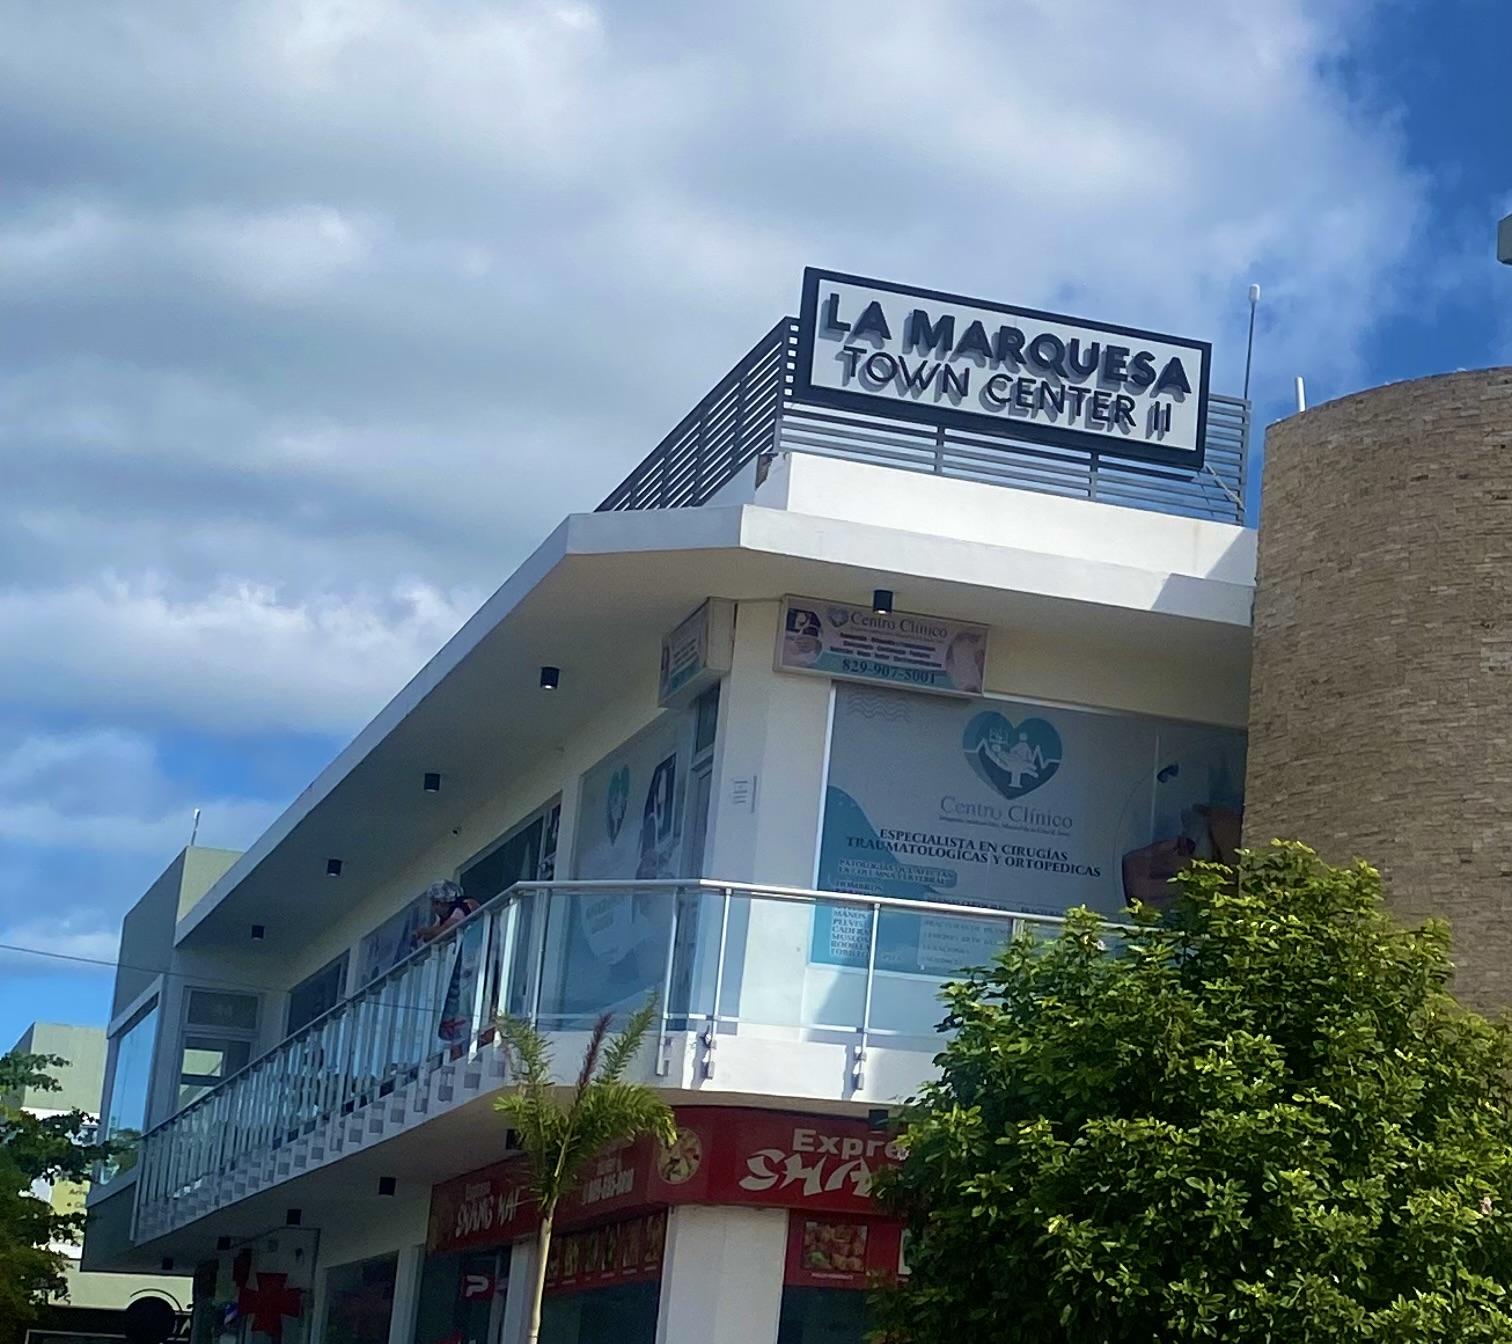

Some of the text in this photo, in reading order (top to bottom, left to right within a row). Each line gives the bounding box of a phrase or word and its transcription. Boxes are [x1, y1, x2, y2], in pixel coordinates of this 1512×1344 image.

[826, 293, 1192, 395] LA MARQUESA
[842, 346, 1172, 433] TOWN CENTER II
[851, 610, 895, 630] Centro
[941, 795, 1002, 820] Centro
[880, 828, 1069, 862] ESPECIALISTA EN CIRUGÍAS
[992, 854, 1000, 865] Y
[793, 1128, 909, 1161] Expre
